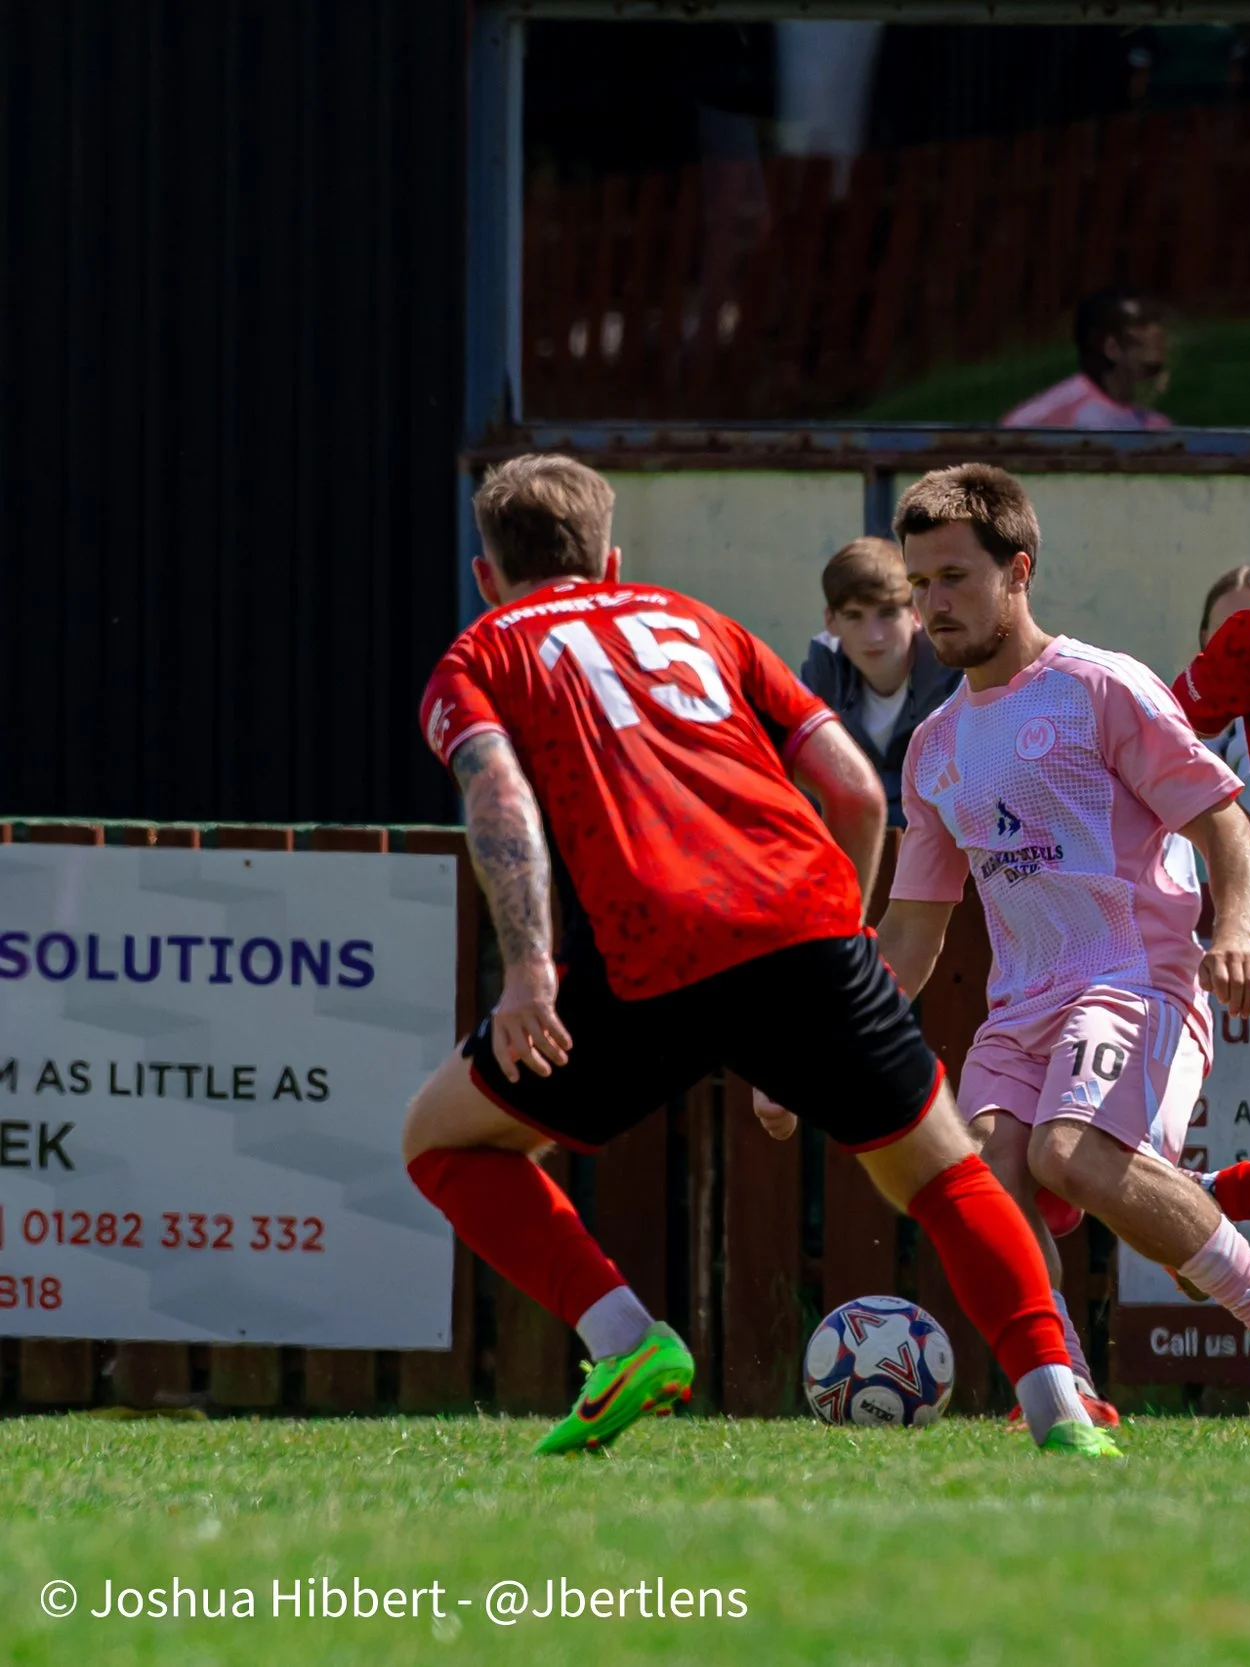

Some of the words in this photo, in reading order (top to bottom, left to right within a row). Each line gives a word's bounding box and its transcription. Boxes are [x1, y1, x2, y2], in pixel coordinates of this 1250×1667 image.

[538, 612, 733, 730] 15
[0, 931, 376, 989] SOLUTIONS
[35, 1059, 92, 1096] AS
[109, 1060, 257, 1100] LITTLE
[272, 1066, 330, 1102] AS
[1071, 1040, 1126, 1083] 10
[22, 1209, 143, 1247] 01282
[160, 1213, 234, 1250] 332
[249, 1216, 325, 1253] 332
[1150, 1326, 1198, 1357] Call
[1205, 1334, 1236, 1357] us
